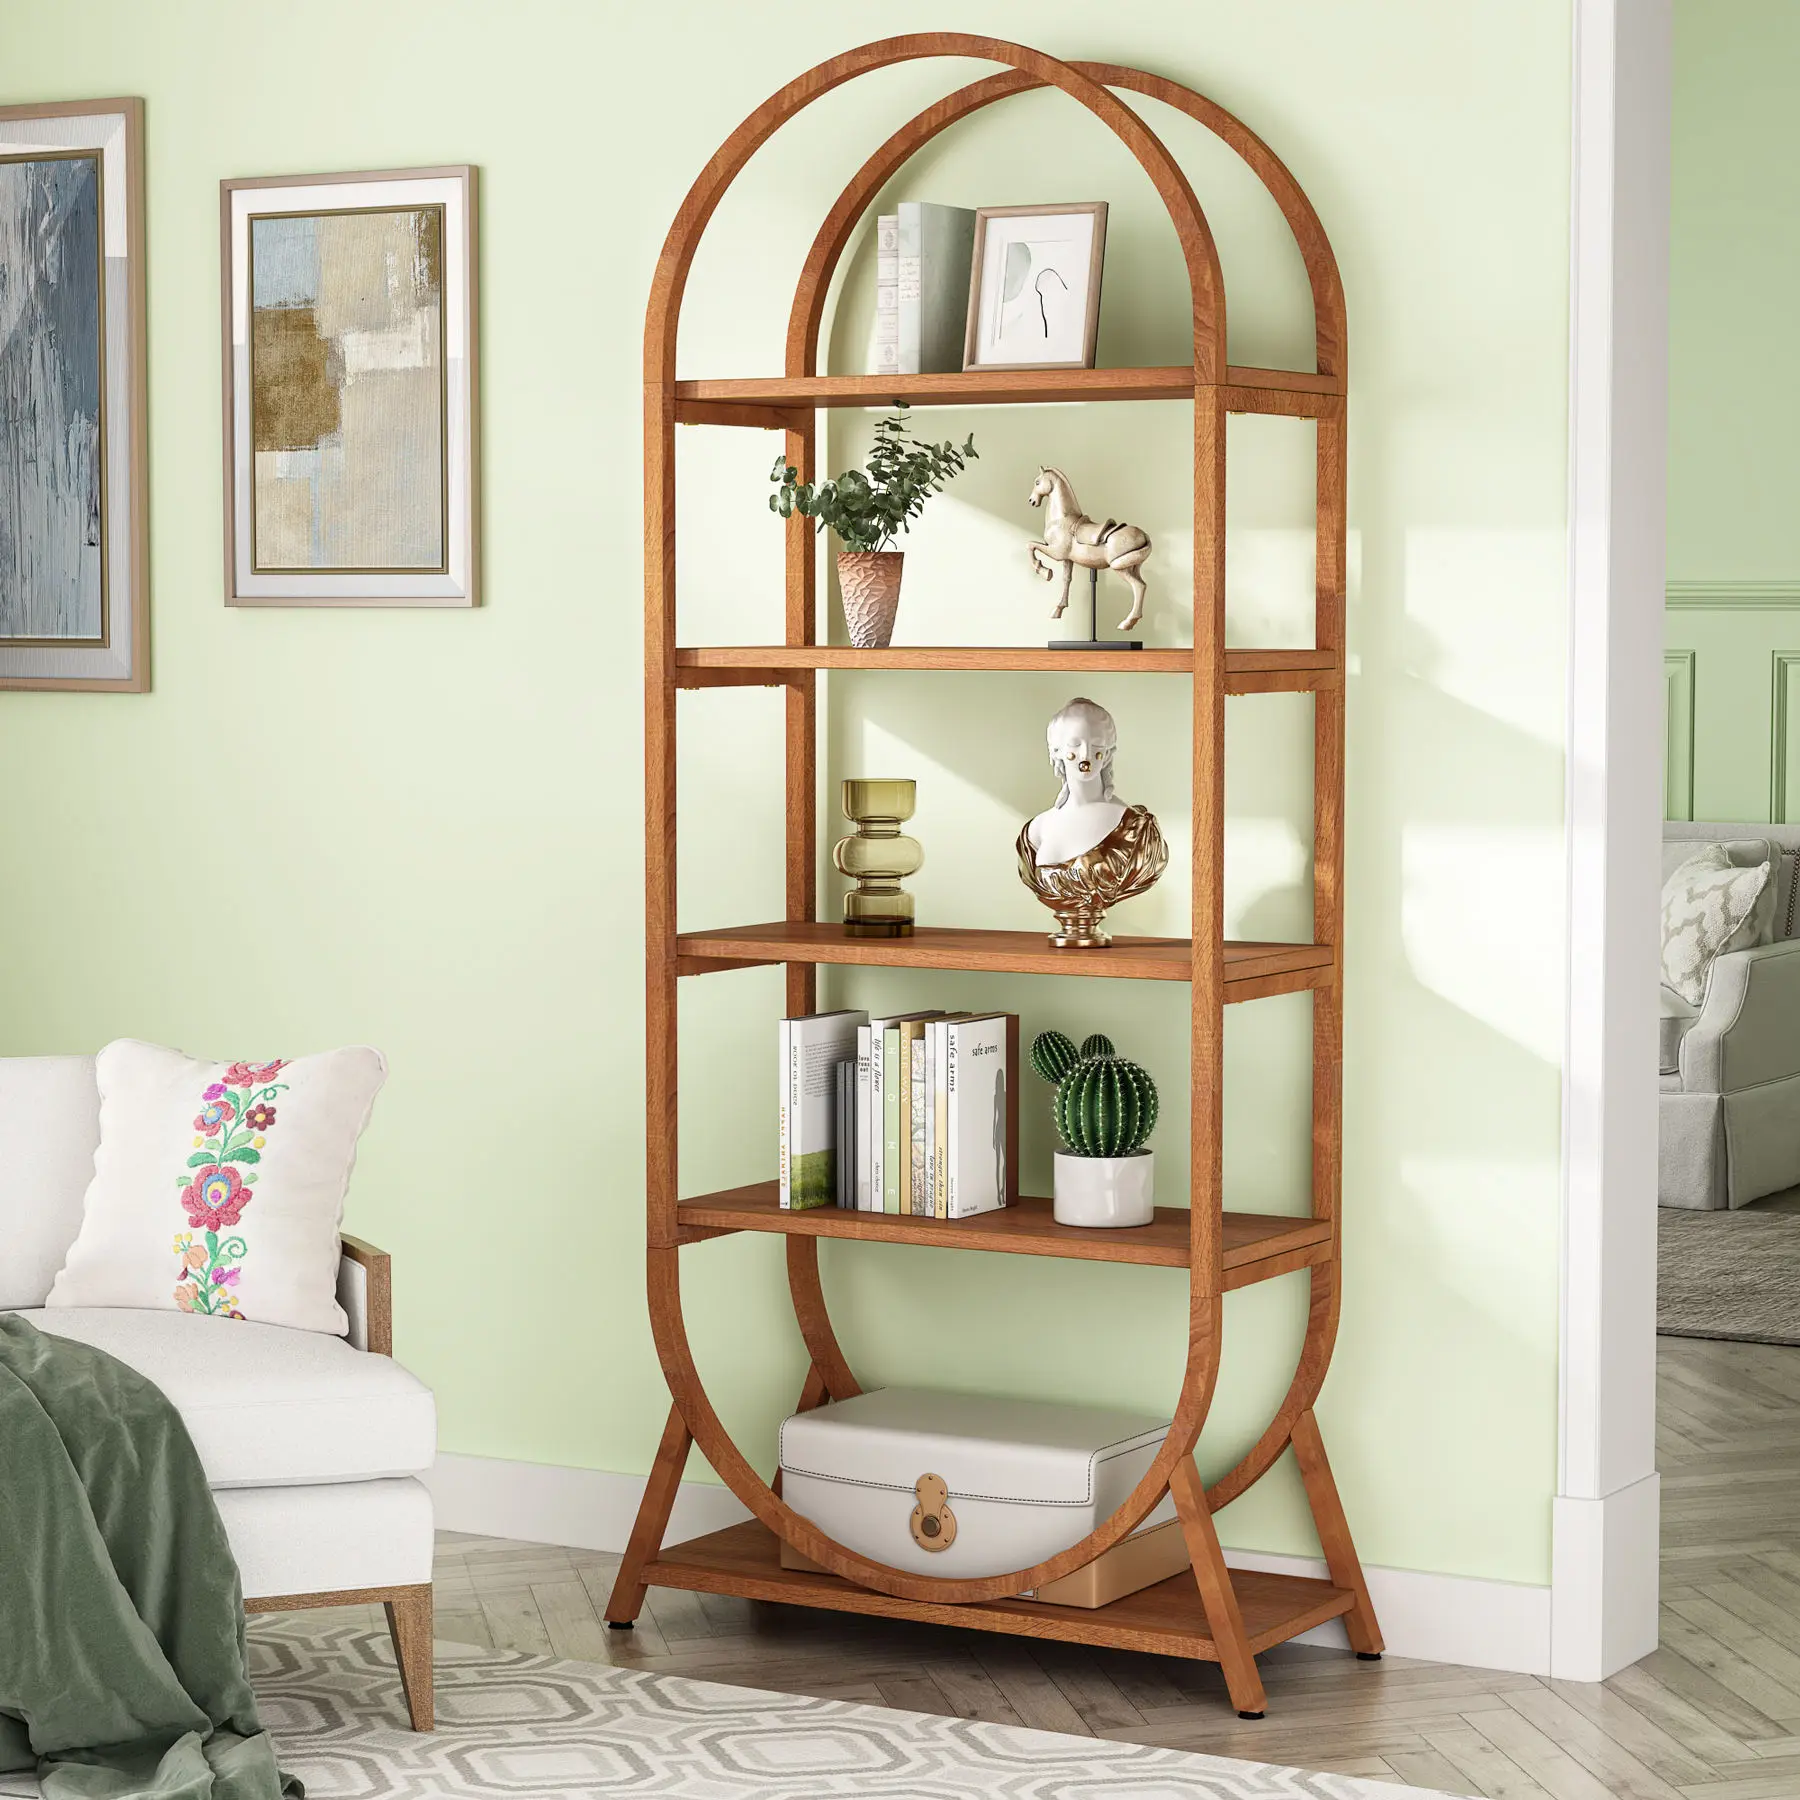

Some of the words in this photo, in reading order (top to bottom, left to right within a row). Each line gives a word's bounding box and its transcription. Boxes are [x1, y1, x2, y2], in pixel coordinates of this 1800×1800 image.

[872, 1038, 882, 1050] life
[949, 1034, 957, 1058] safe
[972, 1042, 983, 1057] safe
[984, 1044, 998, 1055] arms
[872, 1068, 881, 1092] flower
[887, 1047, 896, 1195] HOME
